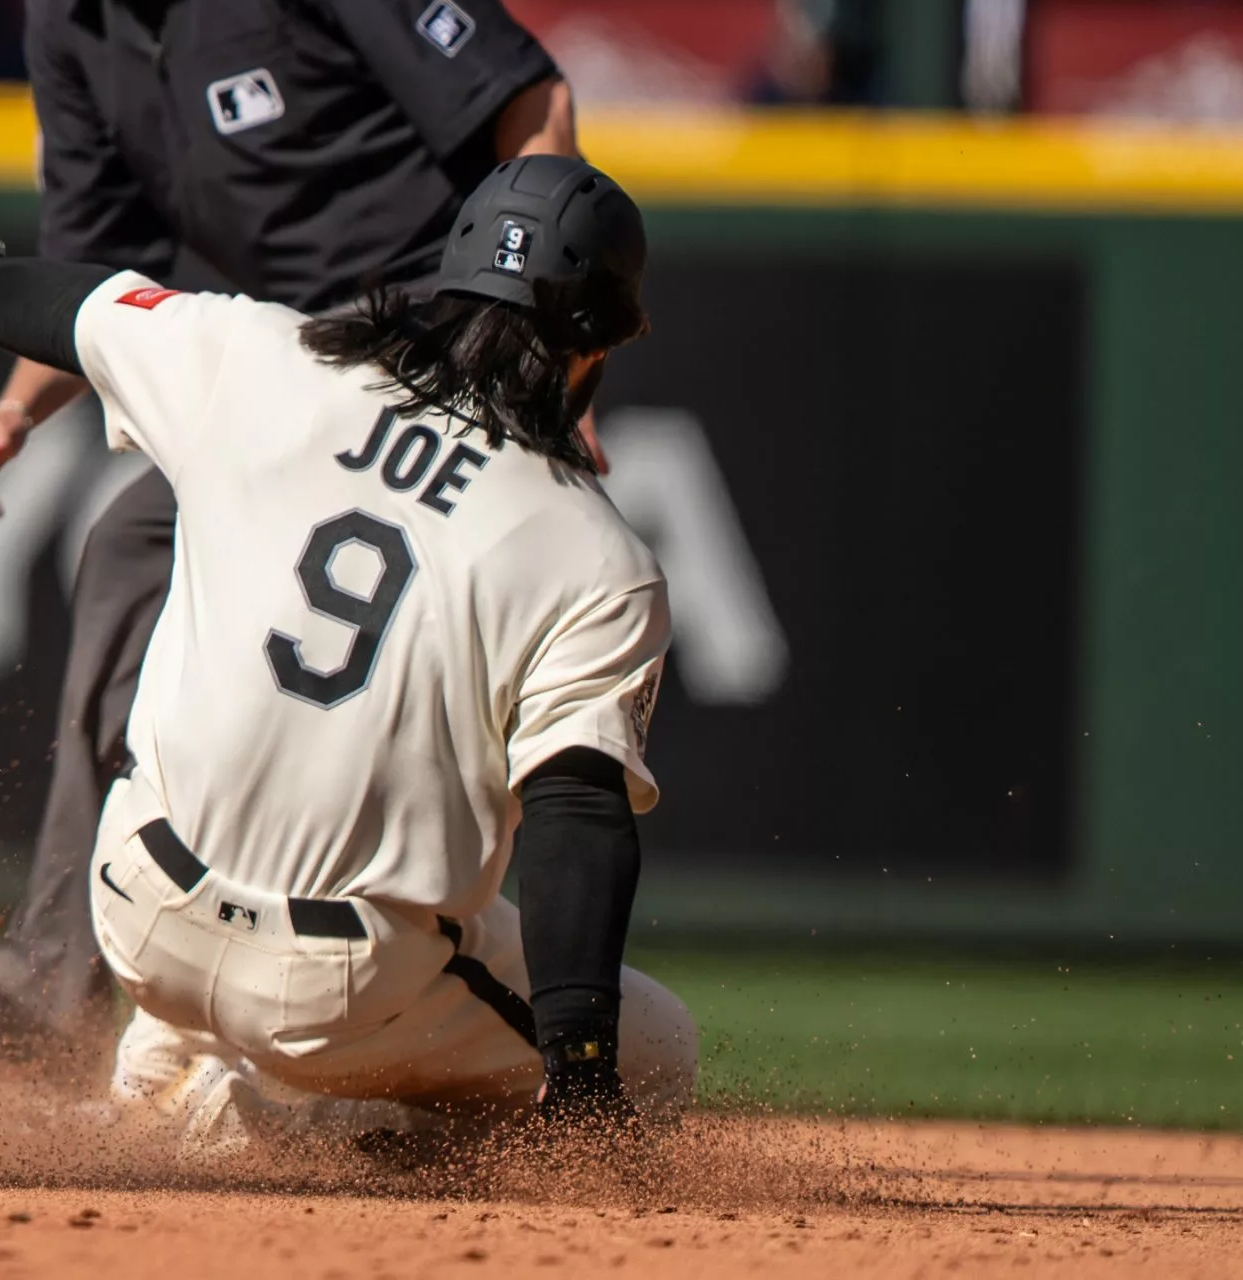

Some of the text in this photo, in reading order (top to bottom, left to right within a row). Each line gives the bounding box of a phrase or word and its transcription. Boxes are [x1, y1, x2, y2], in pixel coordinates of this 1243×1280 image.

[506, 227, 524, 250] 9
[333, 404, 491, 518] JOE
[261, 506, 419, 710] 9
